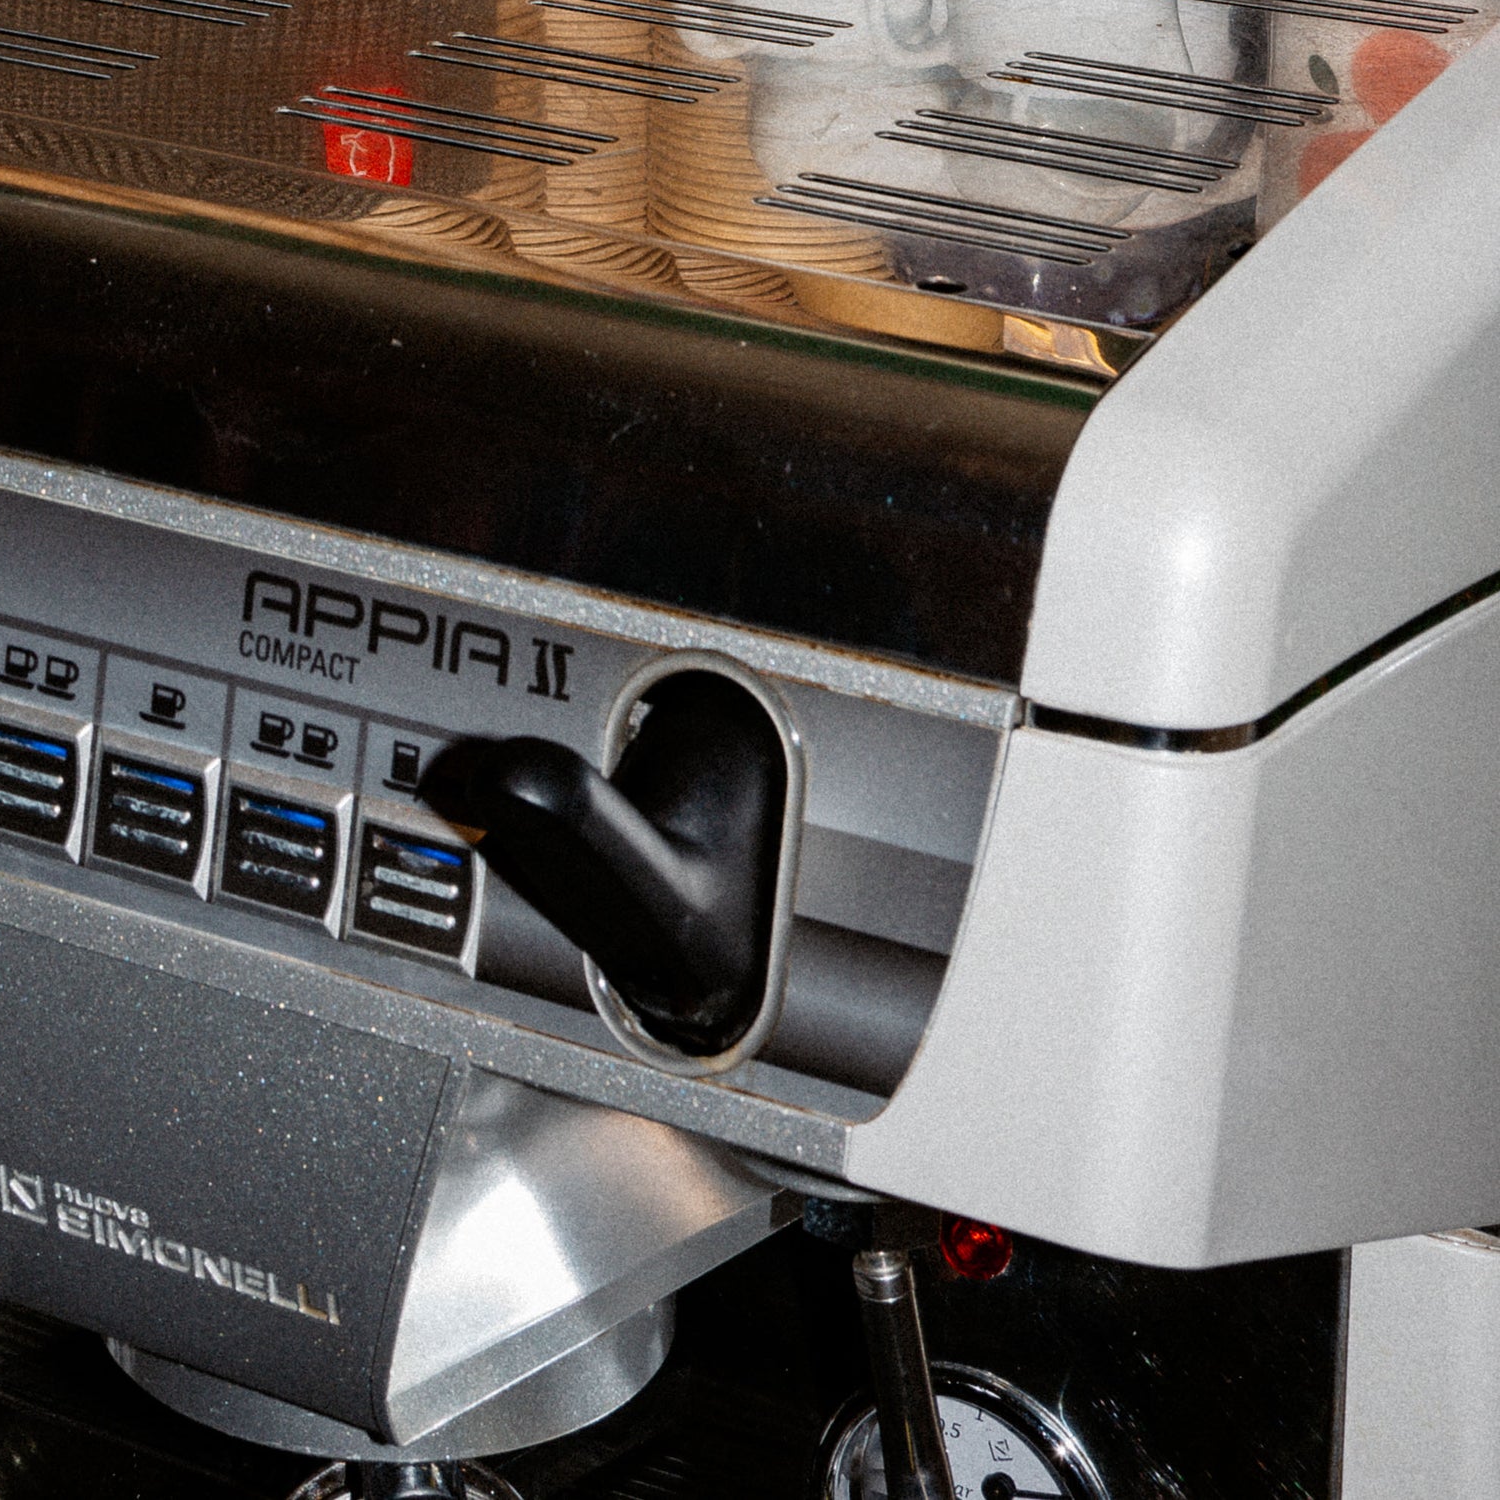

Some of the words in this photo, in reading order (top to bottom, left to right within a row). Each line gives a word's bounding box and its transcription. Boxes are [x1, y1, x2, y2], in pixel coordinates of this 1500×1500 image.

[242, 570, 511, 685] APPIA
[238, 629, 362, 686] COMPACT
[54, 1182, 149, 1228] nuova
[56, 1204, 342, 1326] SIMONELLI
[955, 1484, 973, 1498] ar
